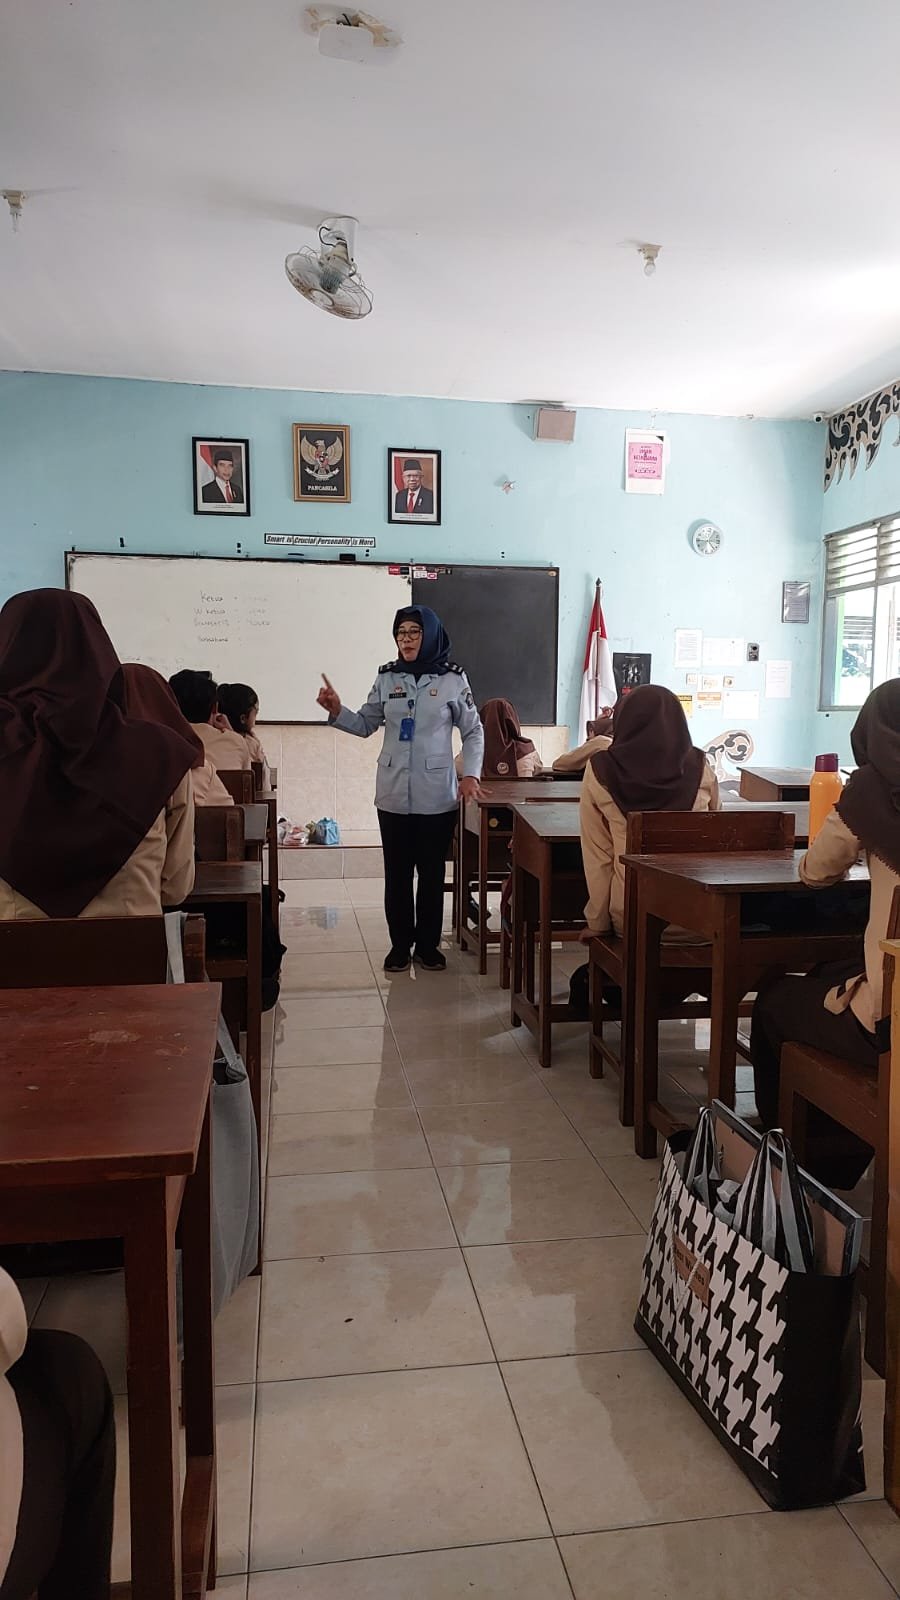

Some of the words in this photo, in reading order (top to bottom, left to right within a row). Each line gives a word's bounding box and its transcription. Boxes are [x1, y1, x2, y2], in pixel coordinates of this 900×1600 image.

[266, 535, 285, 543] Smart
[294, 536, 316, 544] Crucial
[317, 537, 351, 546] Personality
[359, 538, 374, 546] More
